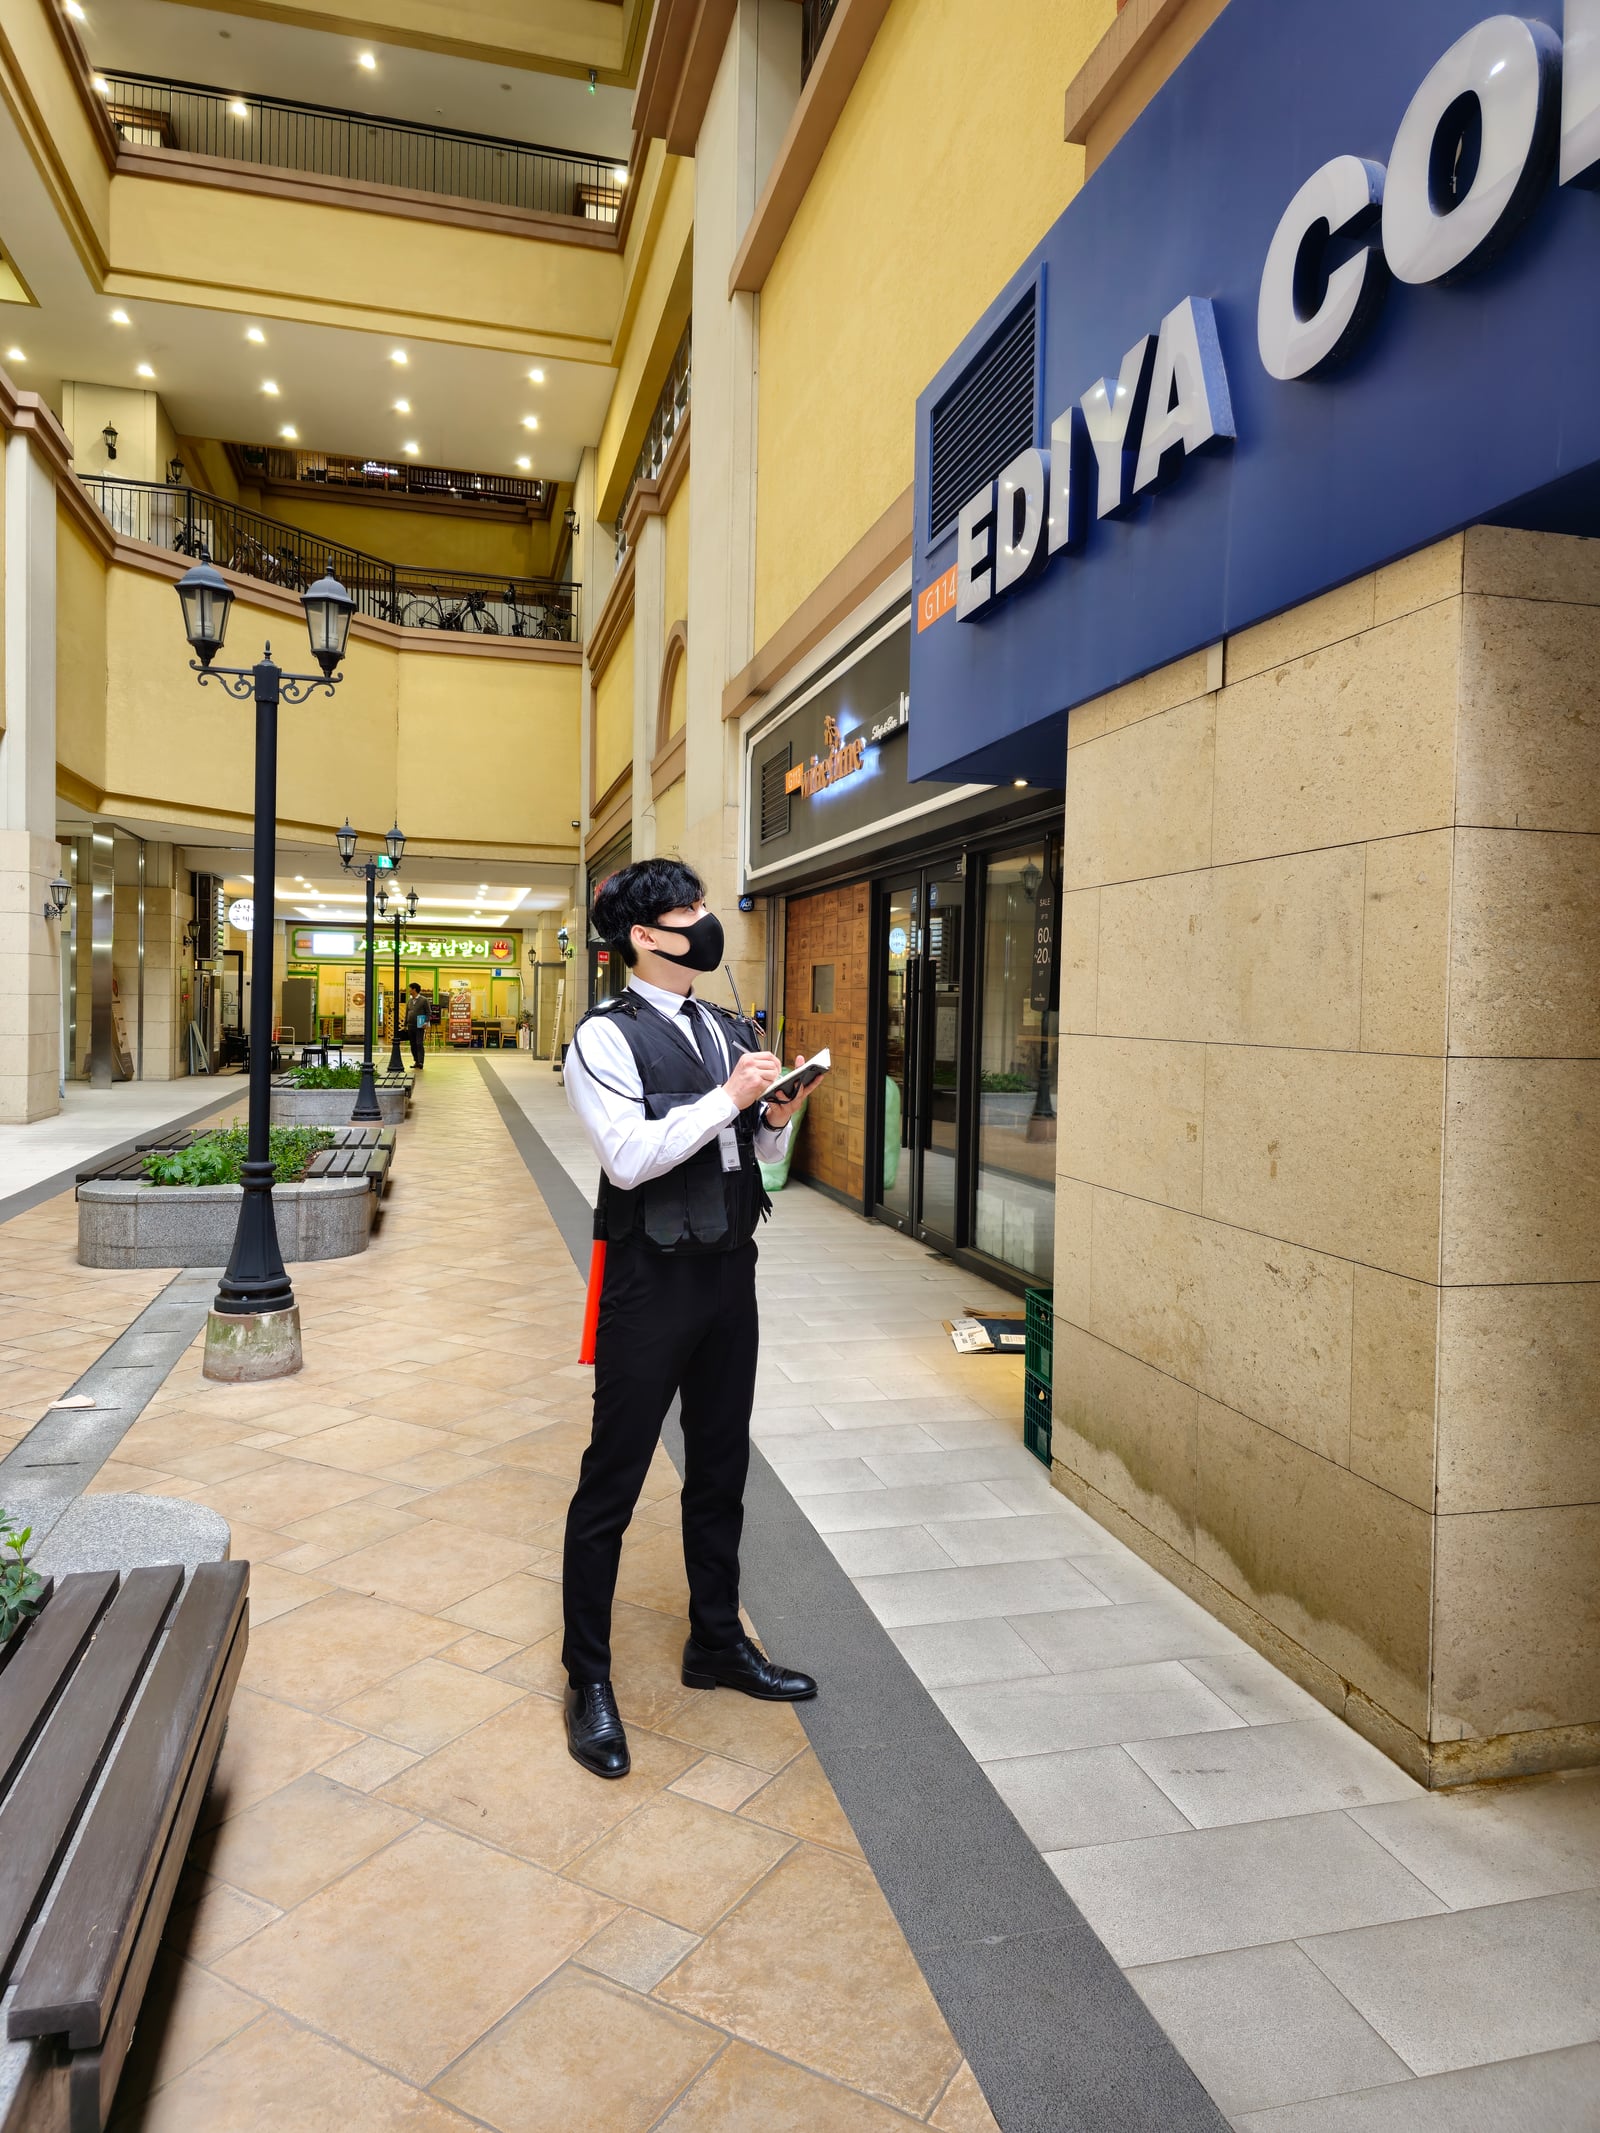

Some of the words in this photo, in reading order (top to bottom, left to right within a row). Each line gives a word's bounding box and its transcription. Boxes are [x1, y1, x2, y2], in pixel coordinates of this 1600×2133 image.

[956, 296, 1222, 622] EDIYA
[1258, 0, 1600, 381] CO
[925, 571, 957, 620] G114
